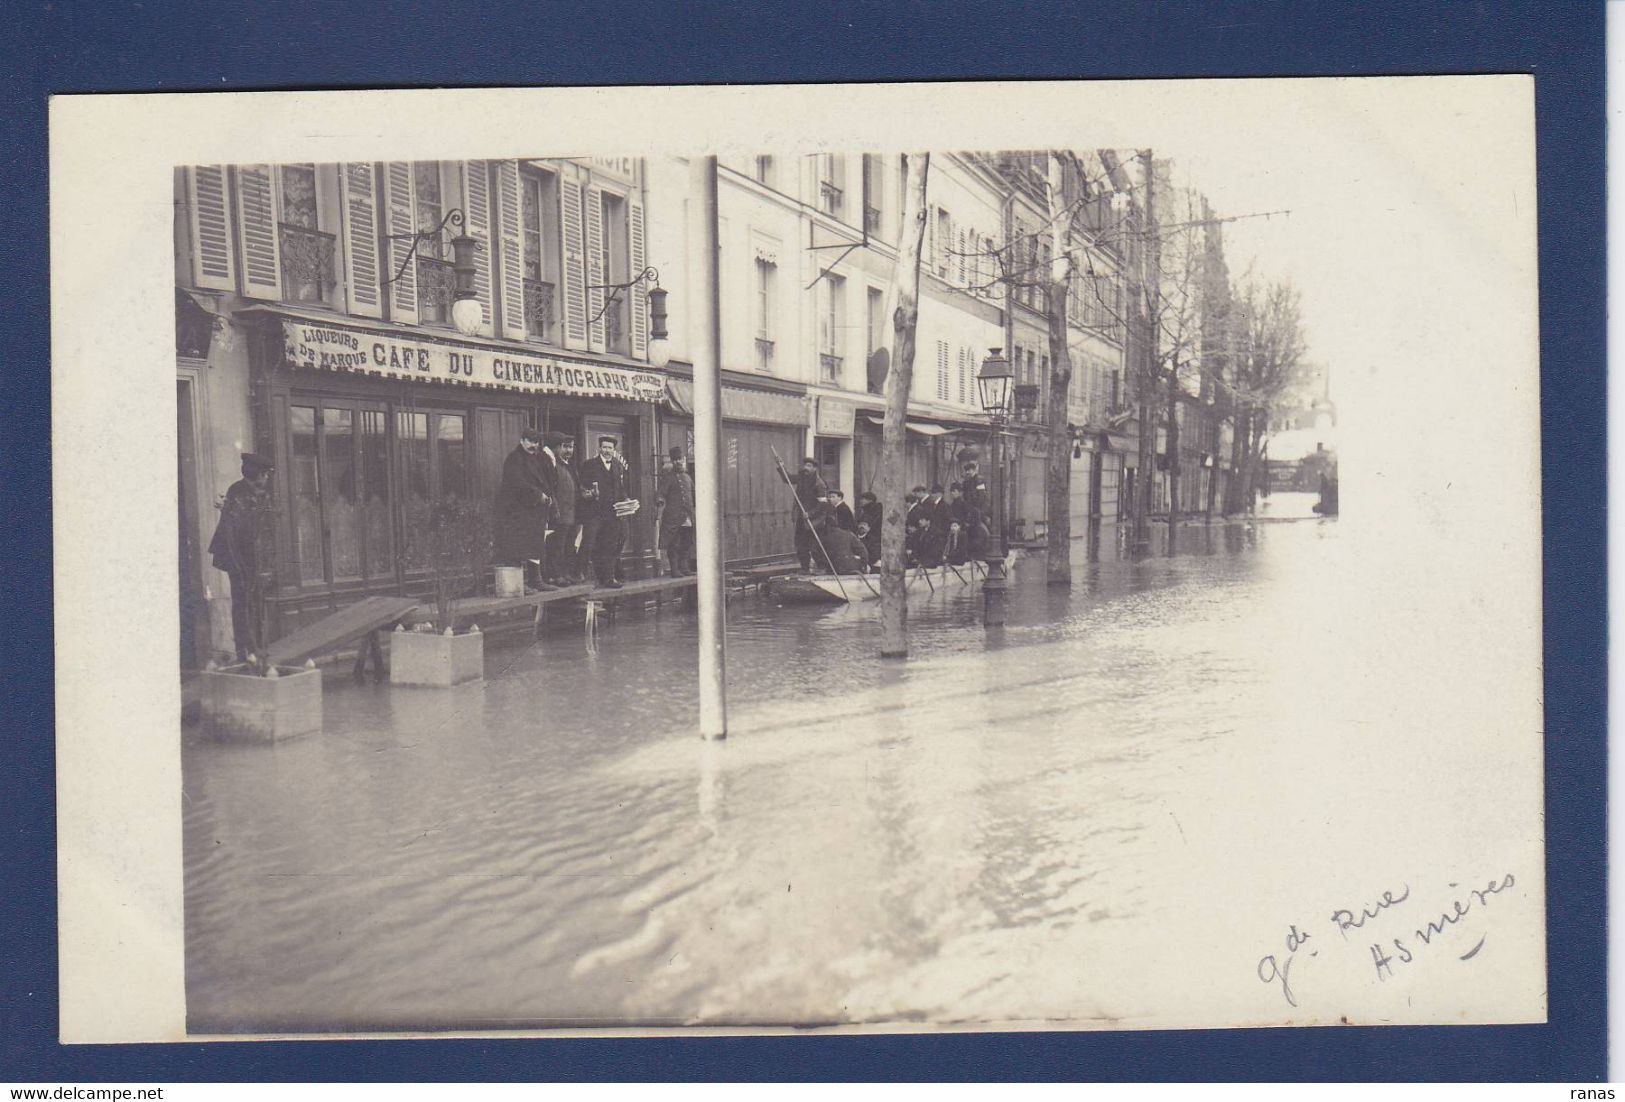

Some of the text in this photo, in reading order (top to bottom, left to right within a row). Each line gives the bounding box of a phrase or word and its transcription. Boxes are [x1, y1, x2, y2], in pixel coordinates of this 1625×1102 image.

[298, 343, 315, 361] DE
[319, 350, 367, 369] MARQUE
[302, 329, 359, 351] LIQUEURS
[373, 342, 630, 392] CAFE DU CINEMATOGRAPHE
[1330, 882, 1410, 942] Rue
